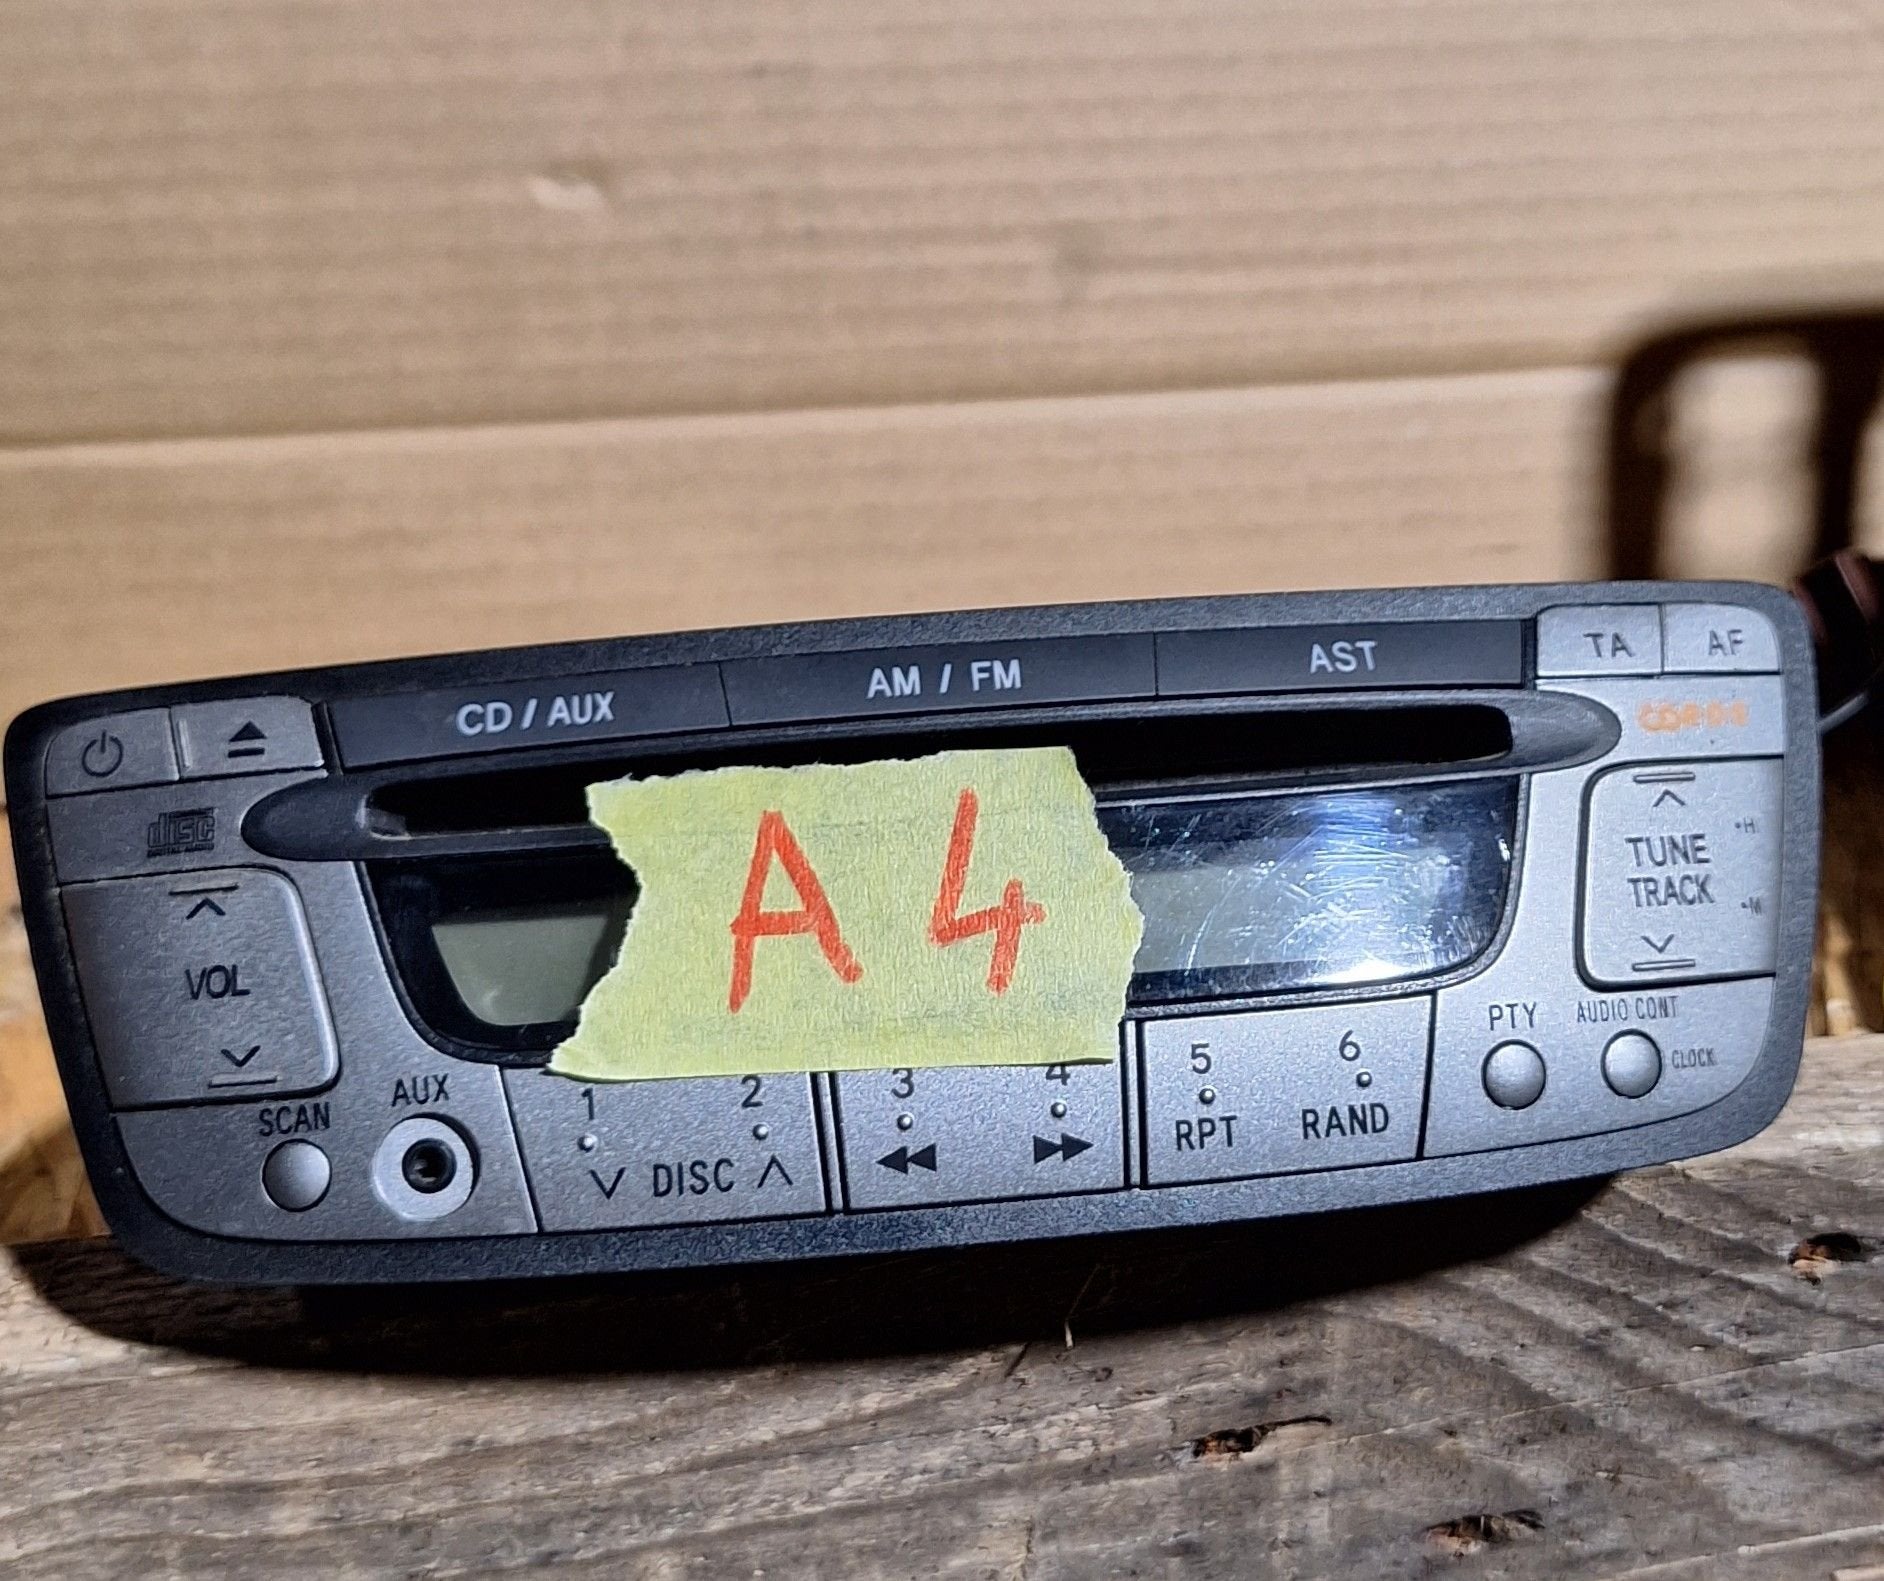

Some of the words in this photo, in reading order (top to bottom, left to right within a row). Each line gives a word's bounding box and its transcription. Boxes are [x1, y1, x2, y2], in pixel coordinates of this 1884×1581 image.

[1310, 640, 1378, 674] AST
[1583, 631, 1636, 658] TA
[1708, 628, 1744, 657] AF
[866, 665, 922, 700] AM
[970, 658, 1023, 692] FM
[455, 701, 514, 737] CD
[547, 690, 616, 728] AUX
[1624, 832, 1712, 868] TUNE
[729, 809, 864, 1015] A
[928, 787, 1047, 997] 4
[1626, 873, 1717, 908] TRACK
[184, 964, 251, 1001] VOL
[1488, 1001, 1538, 1032] PTY
[1576, 999, 1629, 1024] AUDIO
[1634, 994, 1680, 1020] CONT
[1190, 1042, 1212, 1075] 5
[1338, 1029, 1362, 1062] 6
[1671, 1047, 1717, 1070] CLOCK
[391, 1072, 451, 1108] AUX
[740, 1074, 764, 1110] 2
[890, 1067, 916, 1099] 3
[1045, 1063, 1071, 1087] 4
[258, 1101, 332, 1137] SCAN
[581, 1086, 596, 1121] 1
[1175, 1114, 1239, 1151] RPT
[1301, 1102, 1390, 1141] RAND
[652, 1157, 736, 1198] DISC
